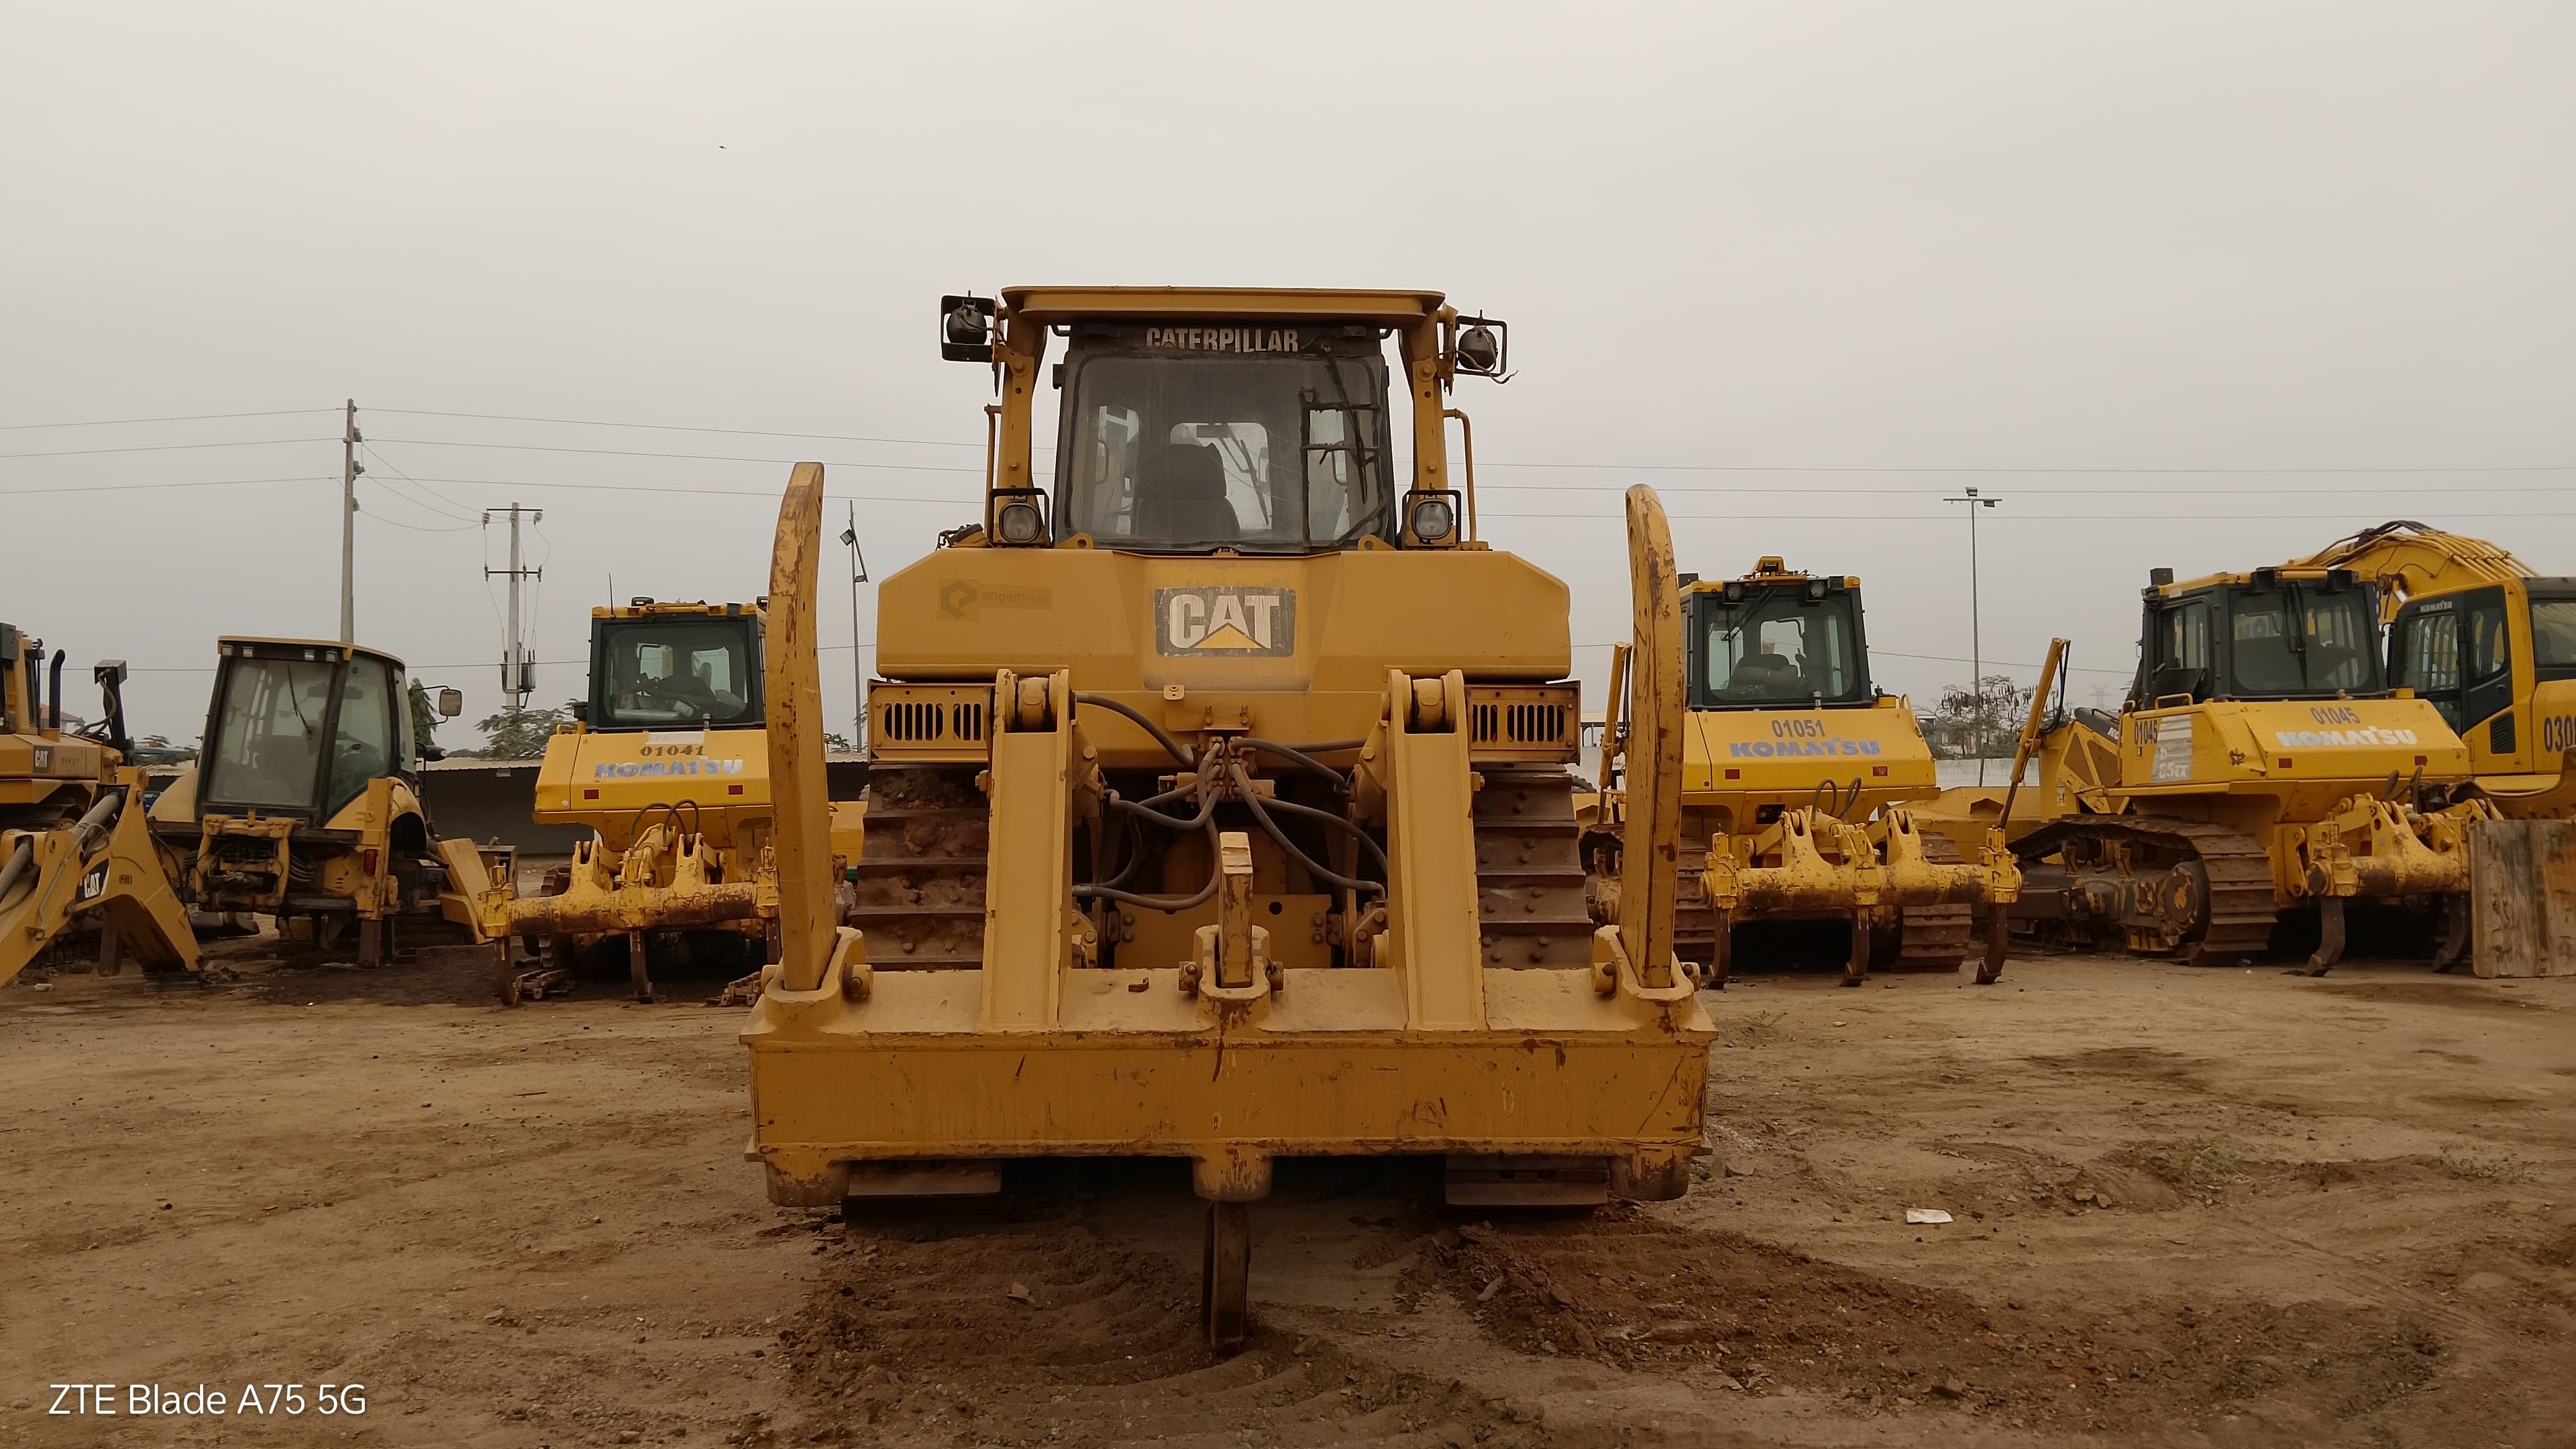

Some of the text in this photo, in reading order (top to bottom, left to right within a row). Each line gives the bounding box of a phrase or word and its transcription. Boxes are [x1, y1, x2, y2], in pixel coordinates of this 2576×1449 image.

[1146, 327, 1299, 353] CATERPILLAR
[982, 590, 1051, 604] engeminas
[2420, 600, 2453, 612] KOMATSU
[1169, 594, 1279, 649] CAT
[2310, 707, 2361, 725] 01045
[1771, 719, 1826, 737] 01051
[2134, 719, 2158, 745] 01045
[2275, 725, 2418, 747] KOMATSU
[2544, 714, 2576, 753] 030
[640, 745, 704, 757] 01041
[1729, 736, 1881, 757] KOMATSU
[35, 749, 48, 767] CAT
[594, 756, 743, 778] KOMATSU
[84, 873, 101, 898] CAT
